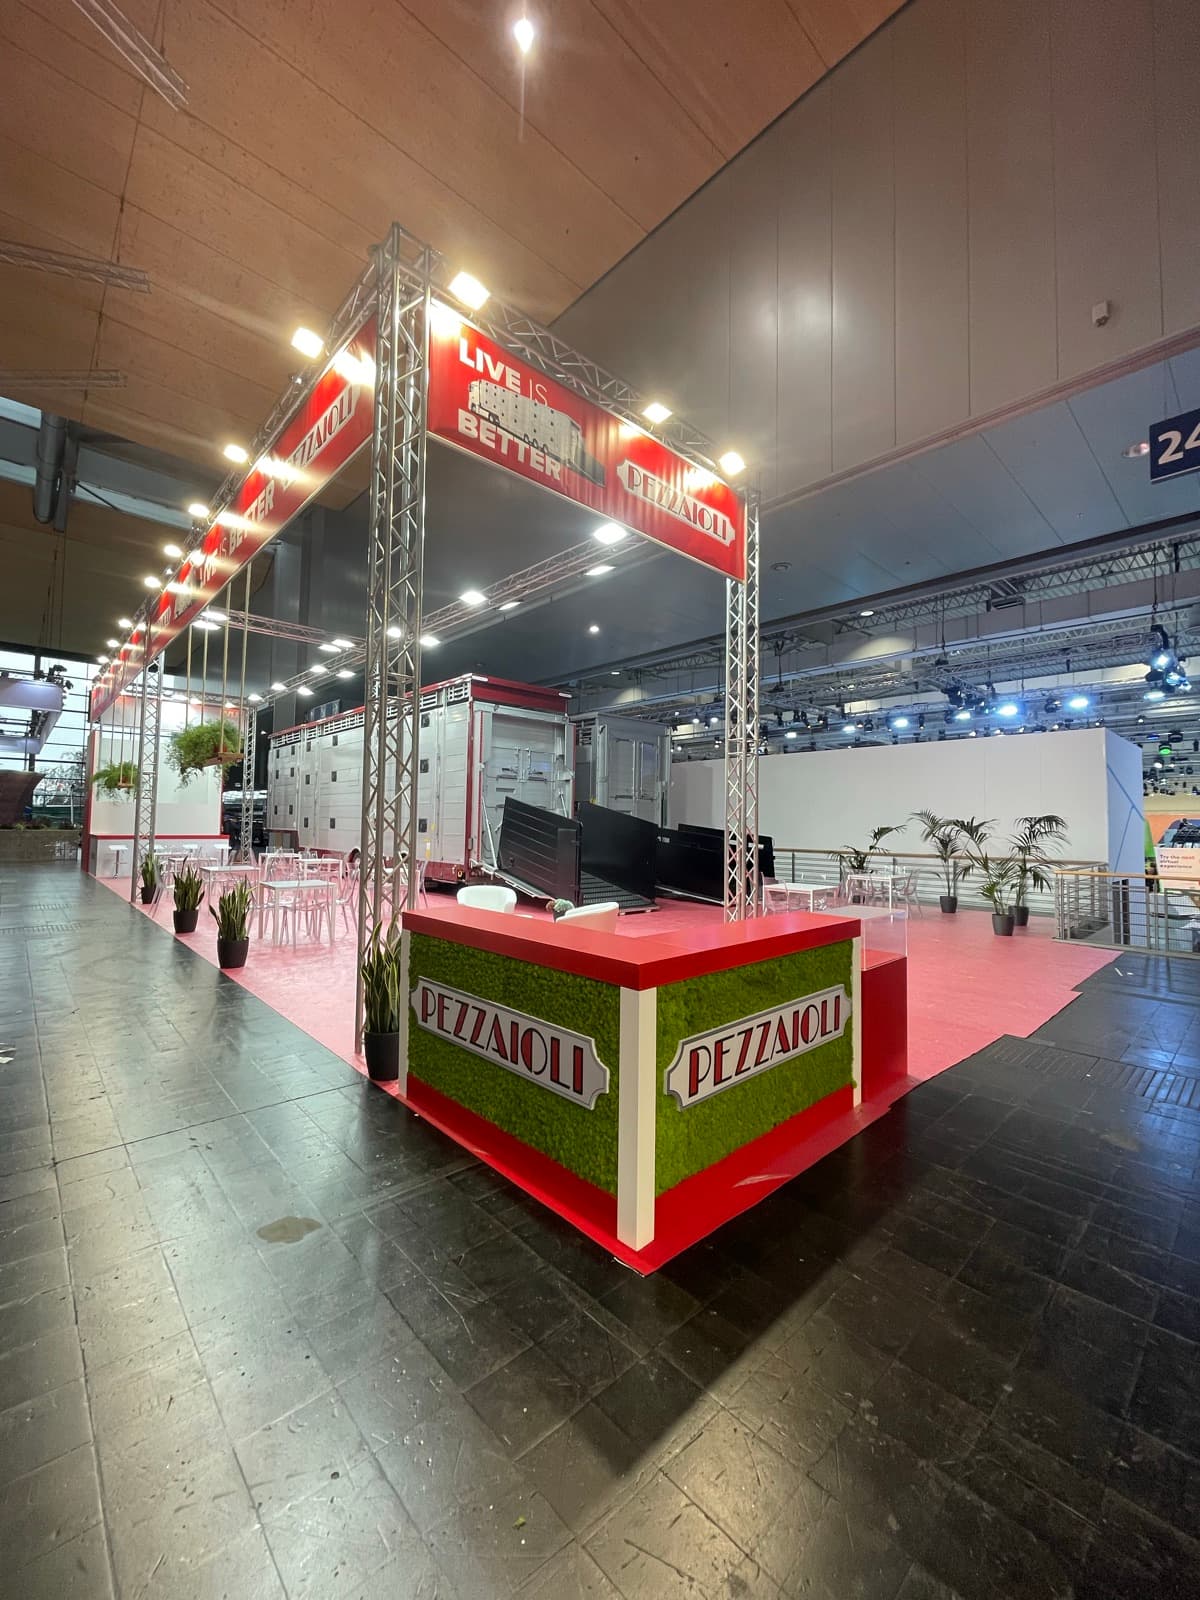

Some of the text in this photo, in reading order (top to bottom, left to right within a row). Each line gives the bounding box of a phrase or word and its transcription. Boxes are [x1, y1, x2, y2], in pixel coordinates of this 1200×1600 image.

[459, 337, 548, 407] LIVE IS
[458, 409, 561, 481] BETTER
[627, 465, 728, 541] PEZZAIOLI
[421, 985, 584, 1095] PEZZAIOLI
[688, 994, 840, 1098] PEZZAIOLI
